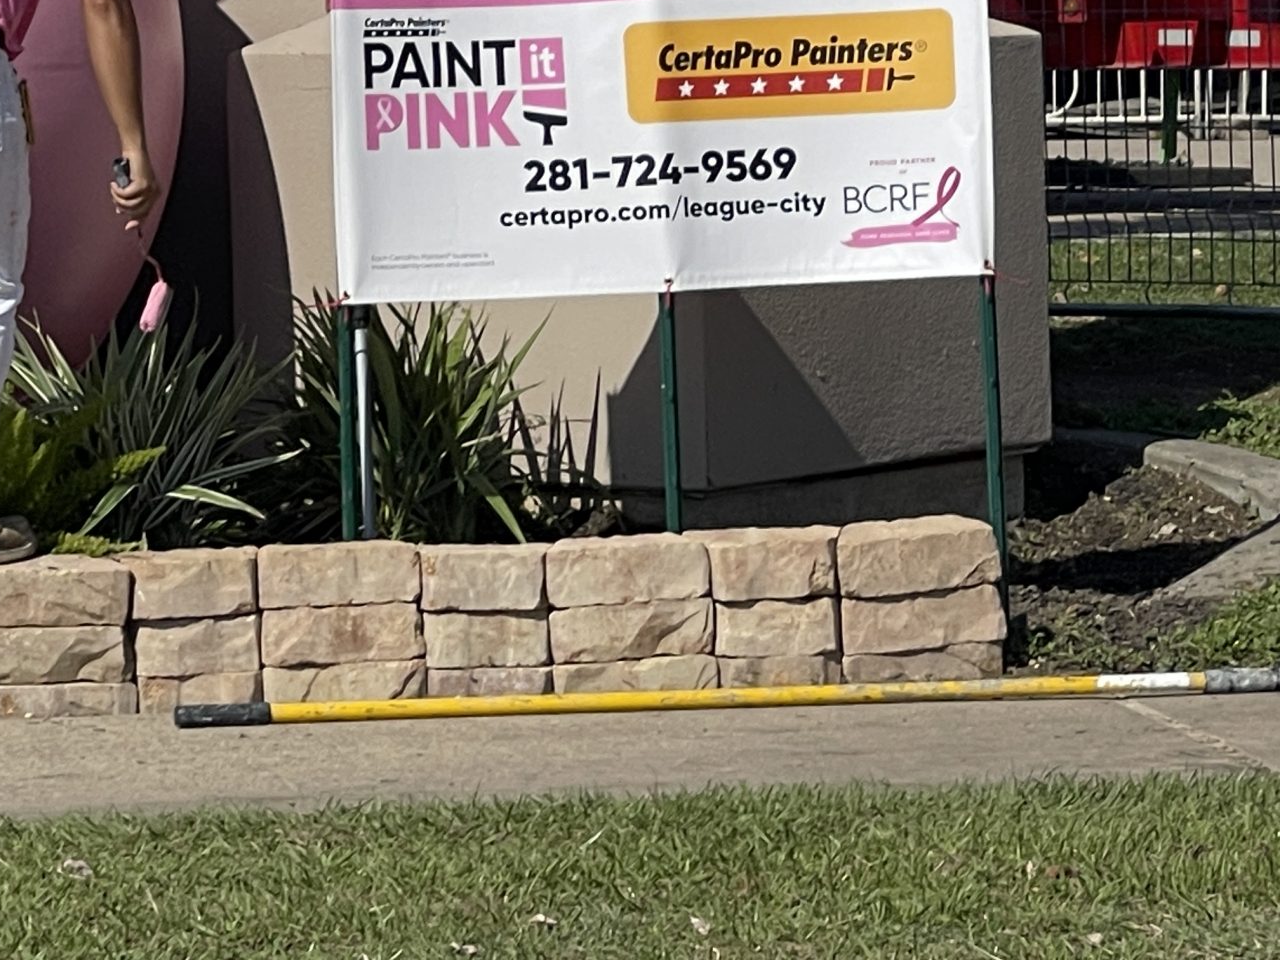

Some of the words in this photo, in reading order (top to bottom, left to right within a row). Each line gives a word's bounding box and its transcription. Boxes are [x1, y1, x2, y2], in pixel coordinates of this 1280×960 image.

[363, 39, 516, 89] PAINT
[528, 43, 556, 79] it
[658, 40, 782, 72] CertaPro
[364, 89, 521, 151] PINK
[522, 146, 797, 193] 281-724-9569
[499, 192, 827, 229] certapro.com/league-city
[843, 181, 931, 215] BCRF
